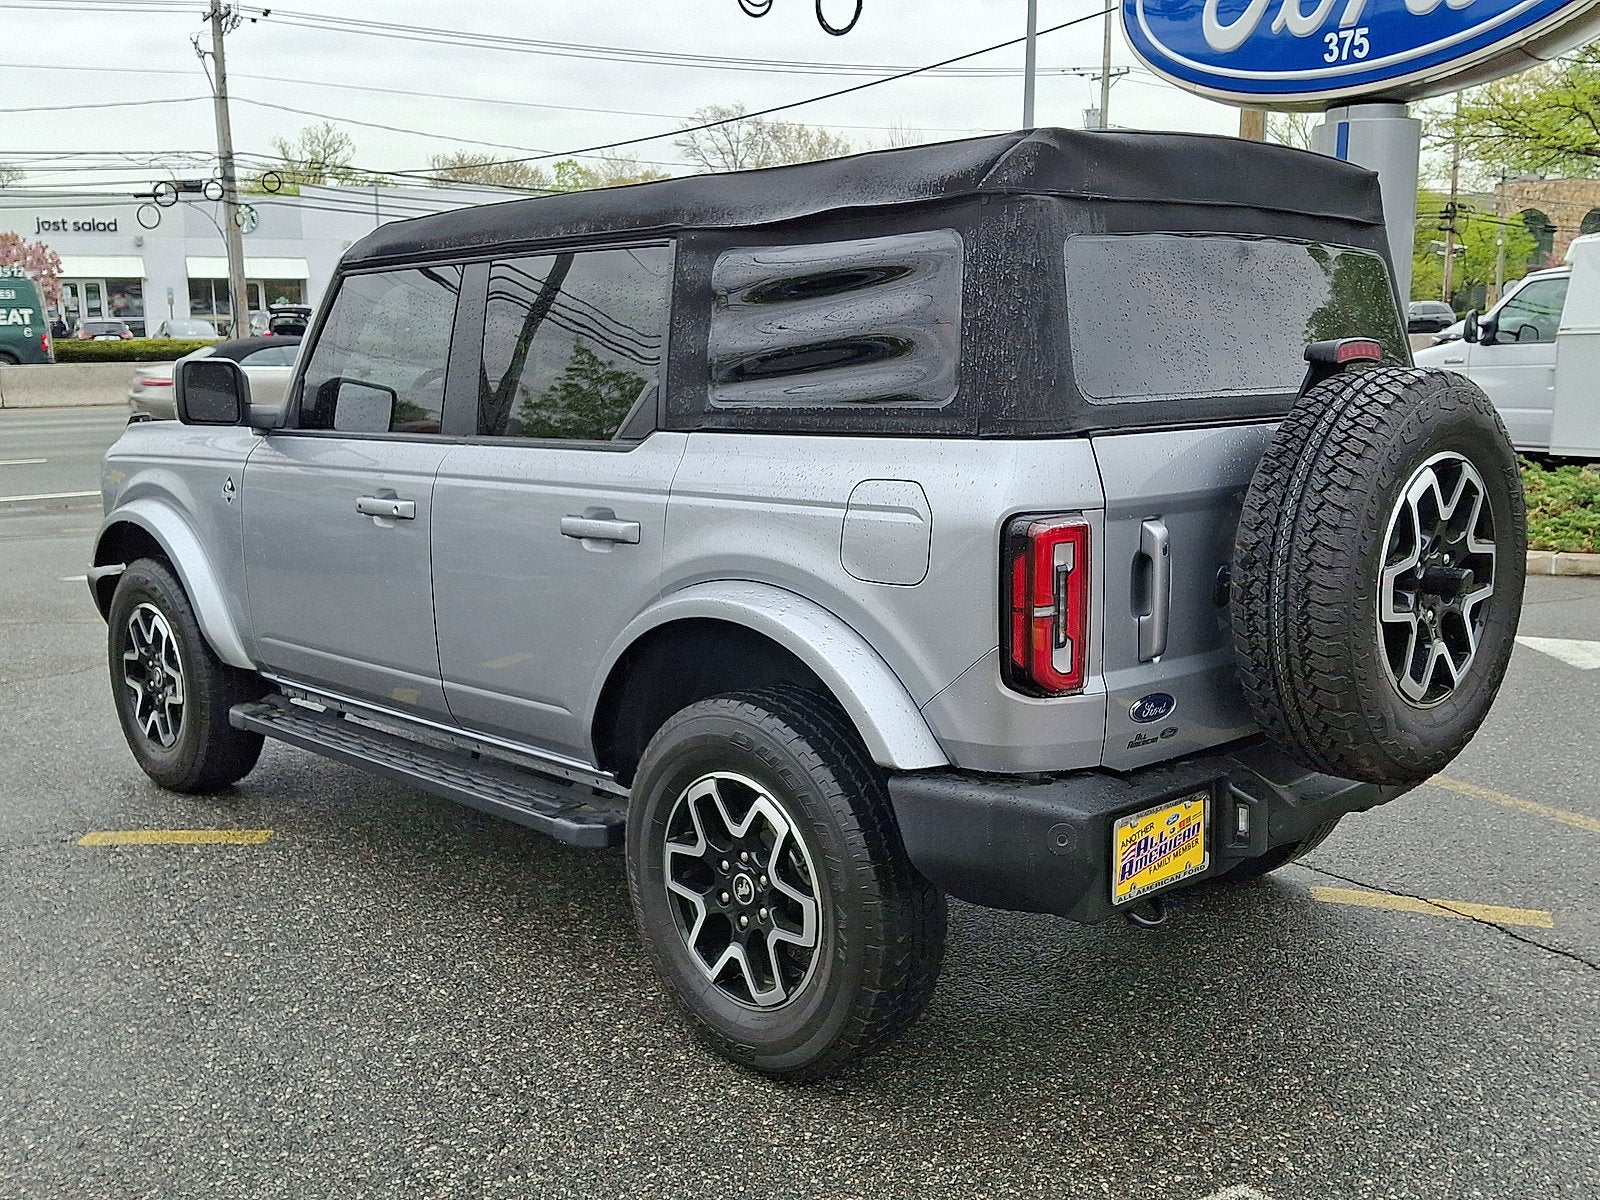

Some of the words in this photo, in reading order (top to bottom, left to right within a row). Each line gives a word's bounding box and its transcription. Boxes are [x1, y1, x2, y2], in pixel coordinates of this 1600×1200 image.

[1323, 27, 1371, 63] 375
[72, 217, 118, 232] salad
[0, 266, 24, 278] 512
[1142, 702, 1167, 718] Ford
[1121, 822, 1155, 850] ANOTHER
[1136, 830, 1168, 857] ALL
[1149, 854, 1172, 875] FAMILY
[1173, 838, 1199, 860] MEMBER
[1117, 893, 1134, 903] ALL
[1136, 874, 1181, 895] AMERICAN
[1183, 865, 1205, 878] FORD
